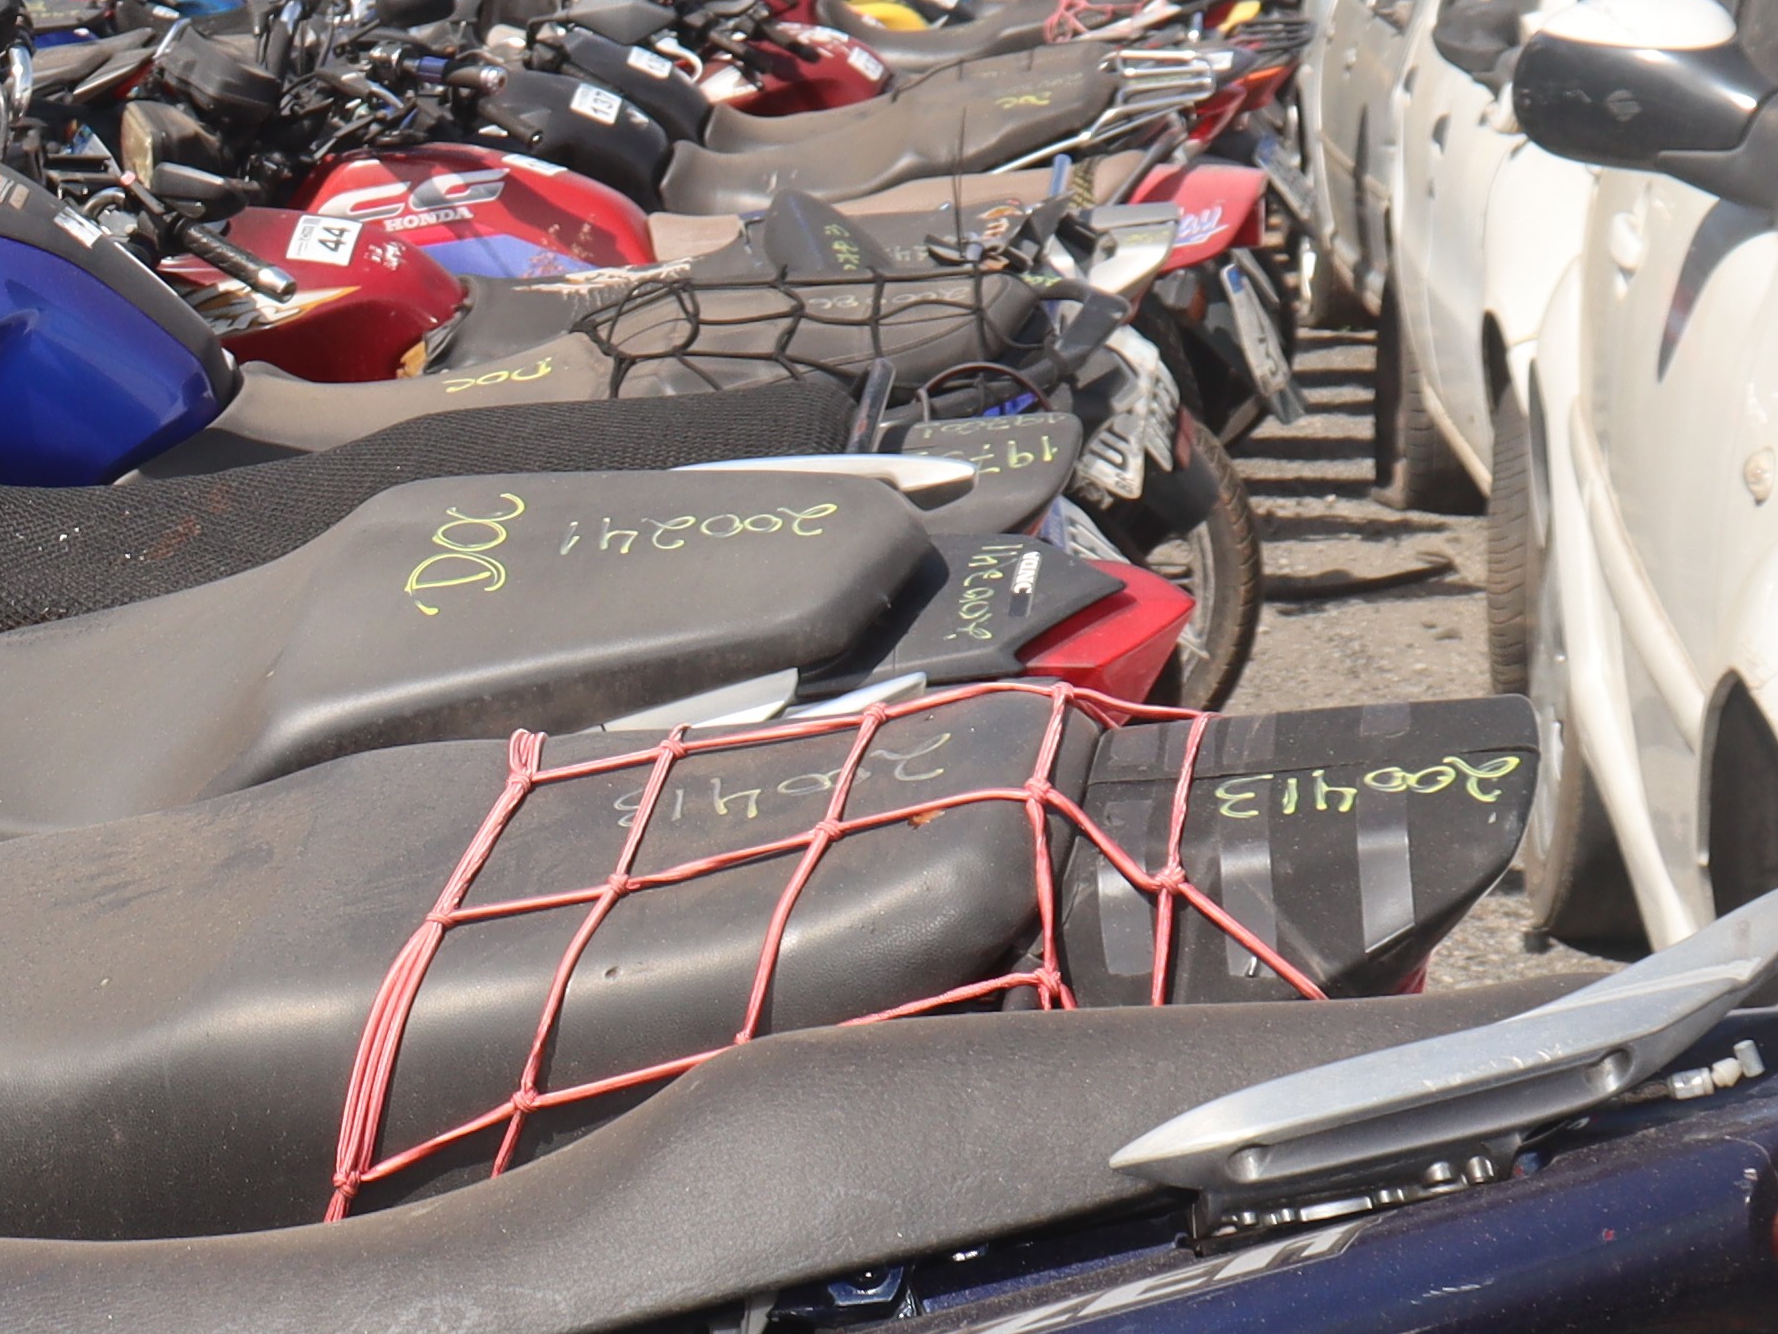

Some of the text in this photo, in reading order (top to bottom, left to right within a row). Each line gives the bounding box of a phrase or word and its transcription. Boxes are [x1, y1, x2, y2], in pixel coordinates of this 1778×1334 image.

[383, 206, 474, 233] HONDA
[317, 226, 351, 254] 44
[1214, 755, 1522, 818] 200413
